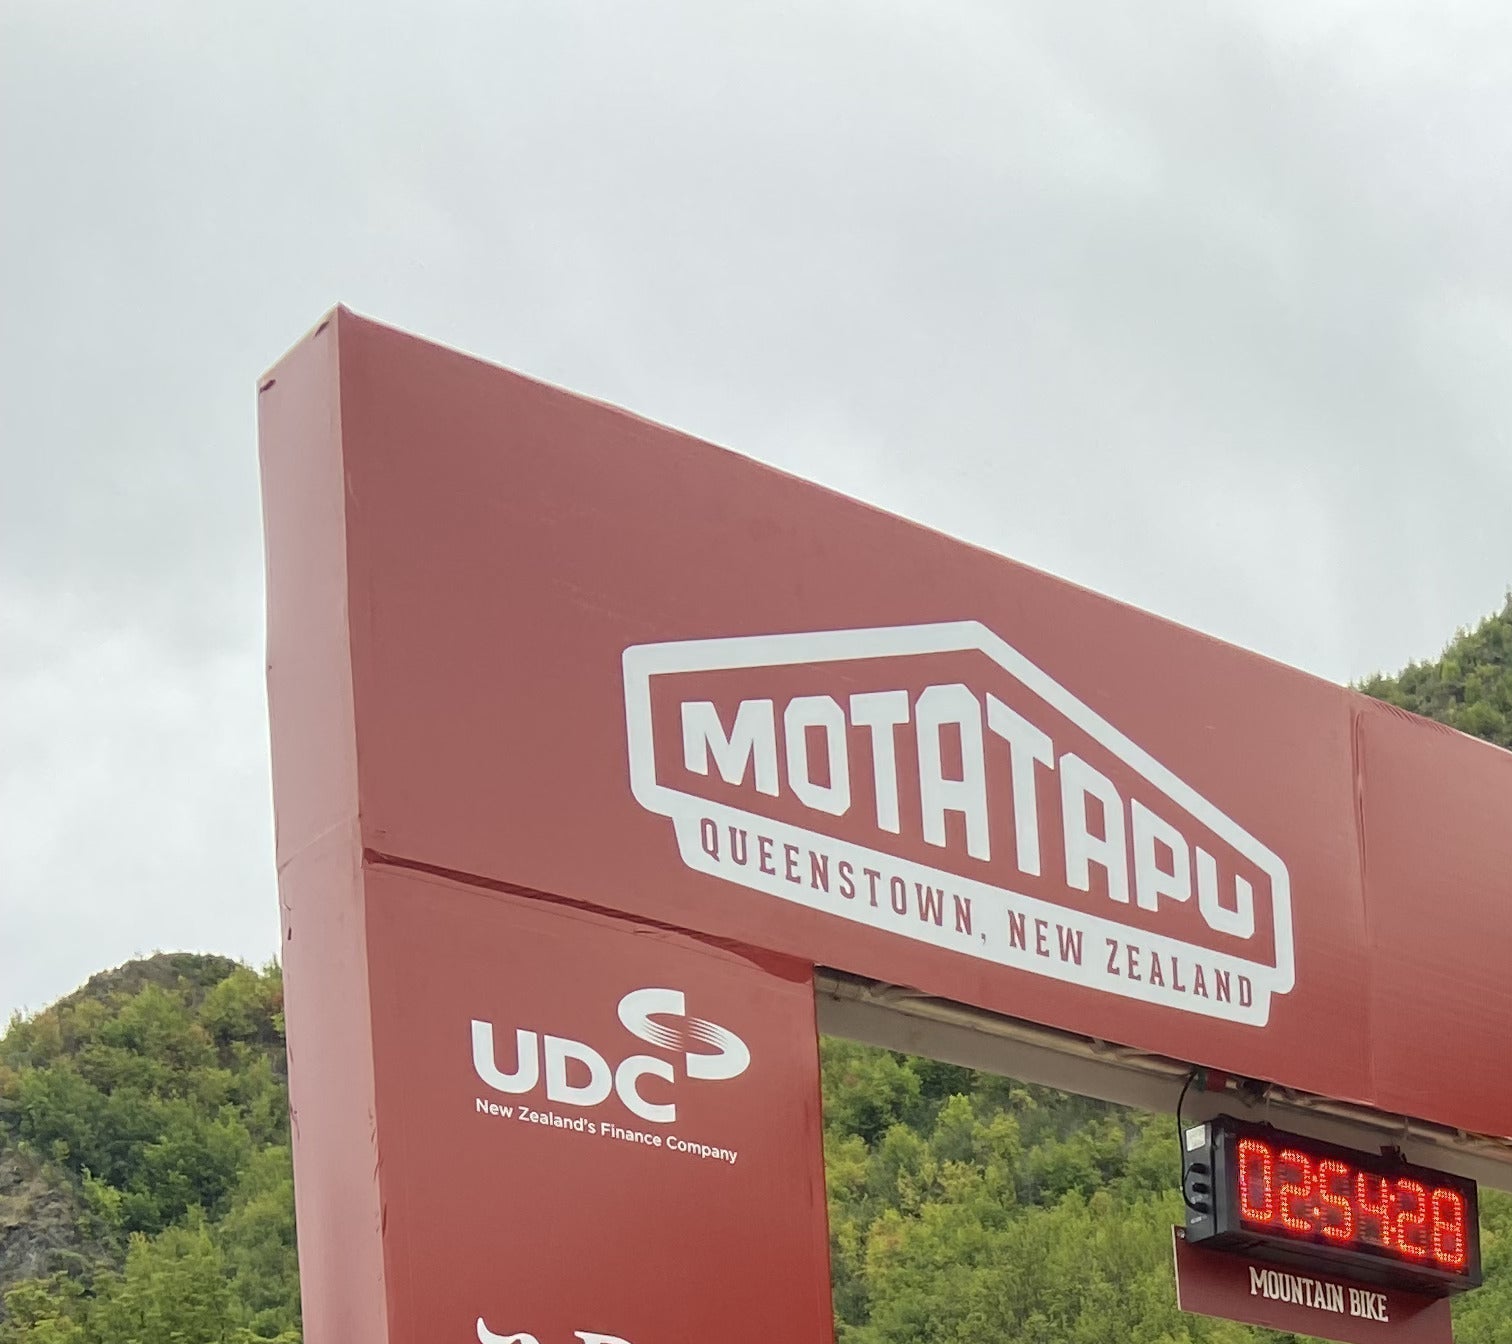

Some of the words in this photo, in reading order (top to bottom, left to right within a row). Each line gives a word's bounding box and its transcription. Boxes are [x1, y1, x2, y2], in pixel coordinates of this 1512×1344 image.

[681, 683, 1254, 939] MOTATAPU
[700, 817, 987, 945] QUEENSTOWN,
[1009, 910, 1083, 967] NEW
[1106, 937, 1254, 1009] ZEALAND
[471, 1019, 676, 1123] UDC
[475, 1098, 513, 1118] New
[518, 1106, 597, 1135] Zealand's
[600, 1122, 662, 1148] Finance
[666, 1135, 738, 1164] Company
[1249, 1266, 1344, 1314] MOUNTAIN
[1348, 1288, 1389, 1323] BIKE
